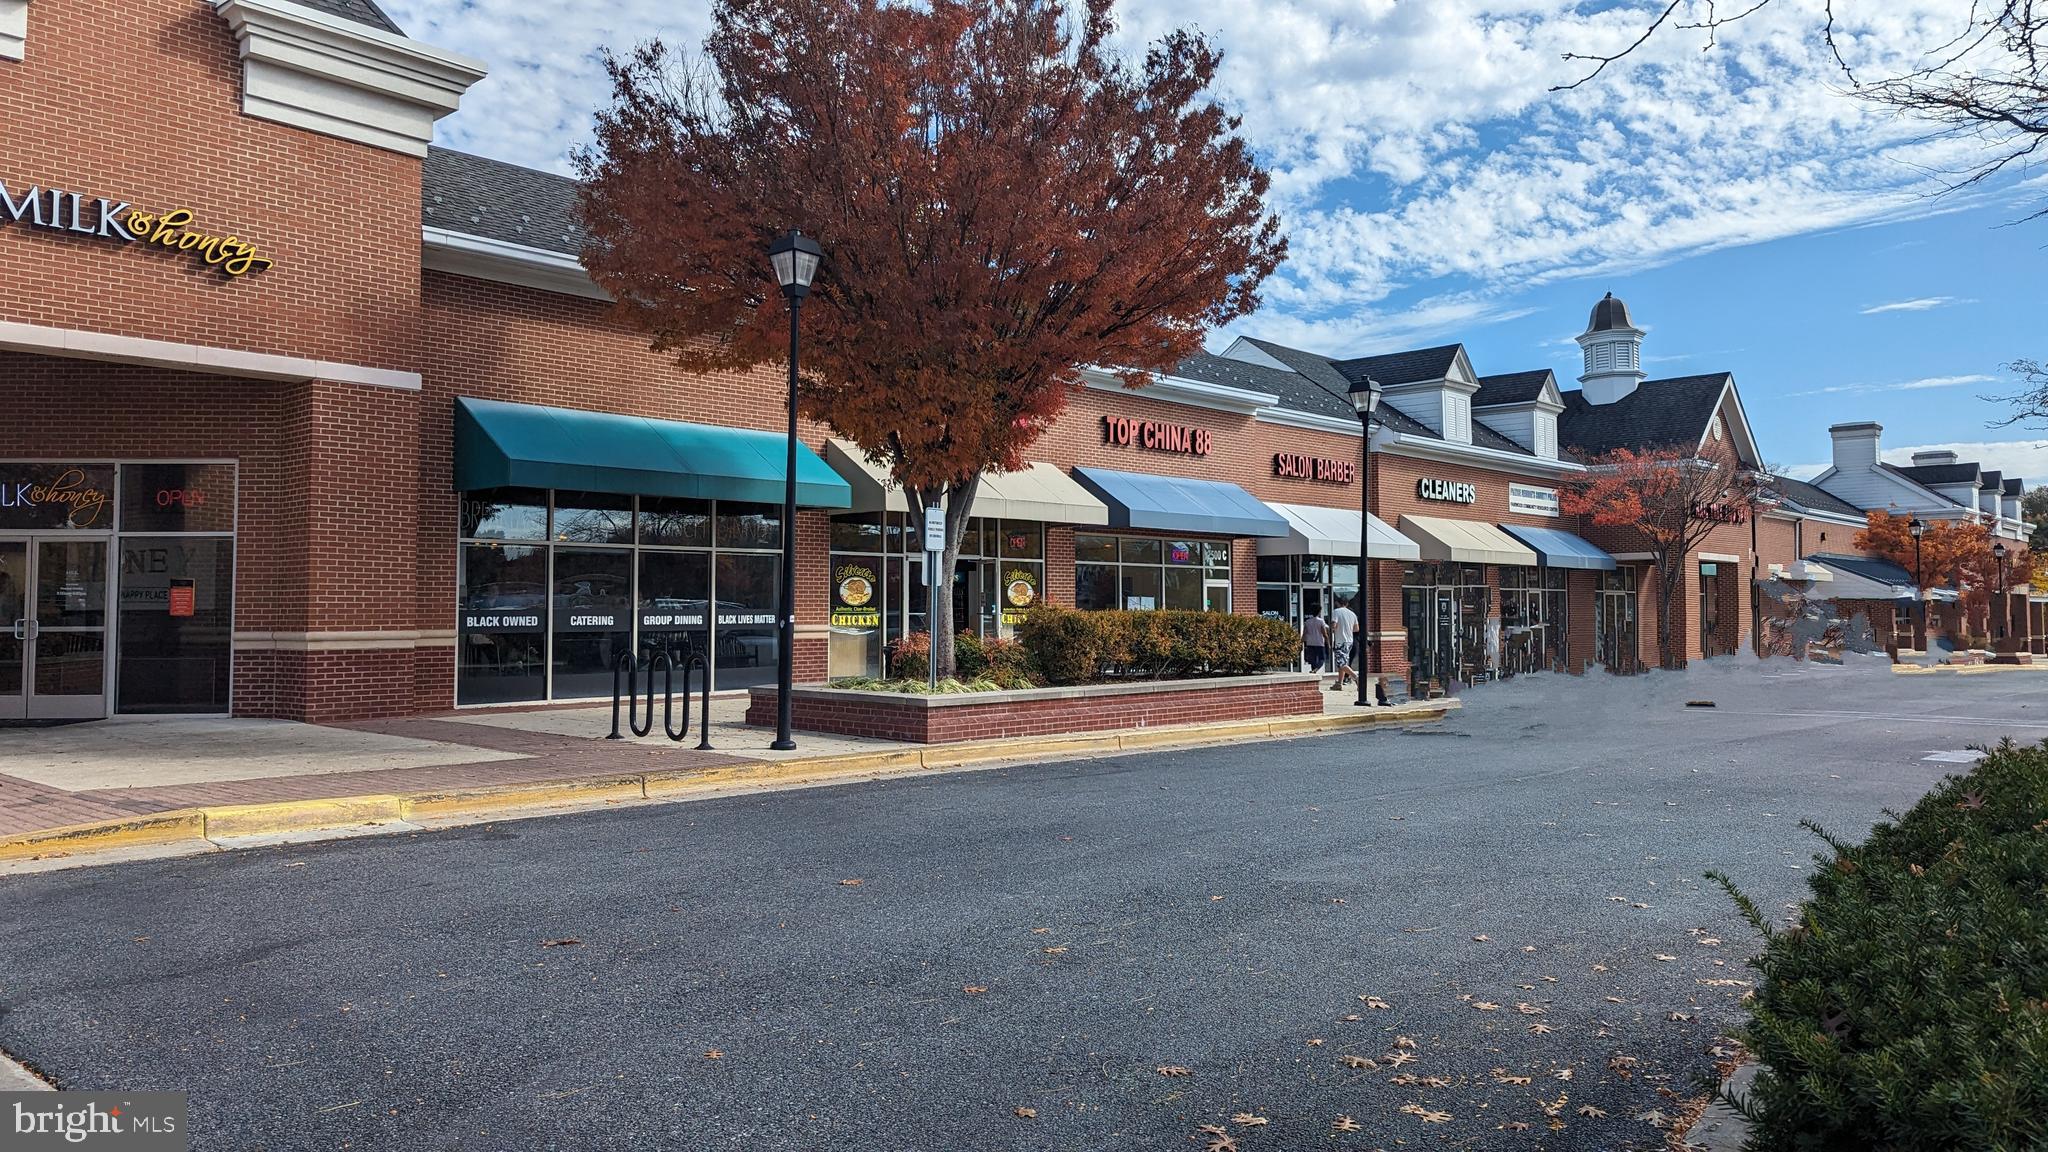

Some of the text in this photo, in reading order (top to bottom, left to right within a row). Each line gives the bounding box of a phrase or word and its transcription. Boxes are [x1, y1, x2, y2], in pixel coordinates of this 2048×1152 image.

[0, 178, 137, 241] MILK
[1105, 416, 1212, 455] TOP CHINA 88
[1277, 452, 1355, 483] SALON BARBER
[1419, 477, 1477, 504] CLEANERS
[156, 489, 205, 508] OPEN
[145, 590, 168, 601] PLACE
[466, 615, 538, 628] BLACK OWNED
[570, 615, 614, 626] CATERING
[643, 614, 702, 626] GROUP DINING
[718, 614, 776, 625] BLACK LIVES MATTER
[831, 614, 879, 625] CHICKEN
